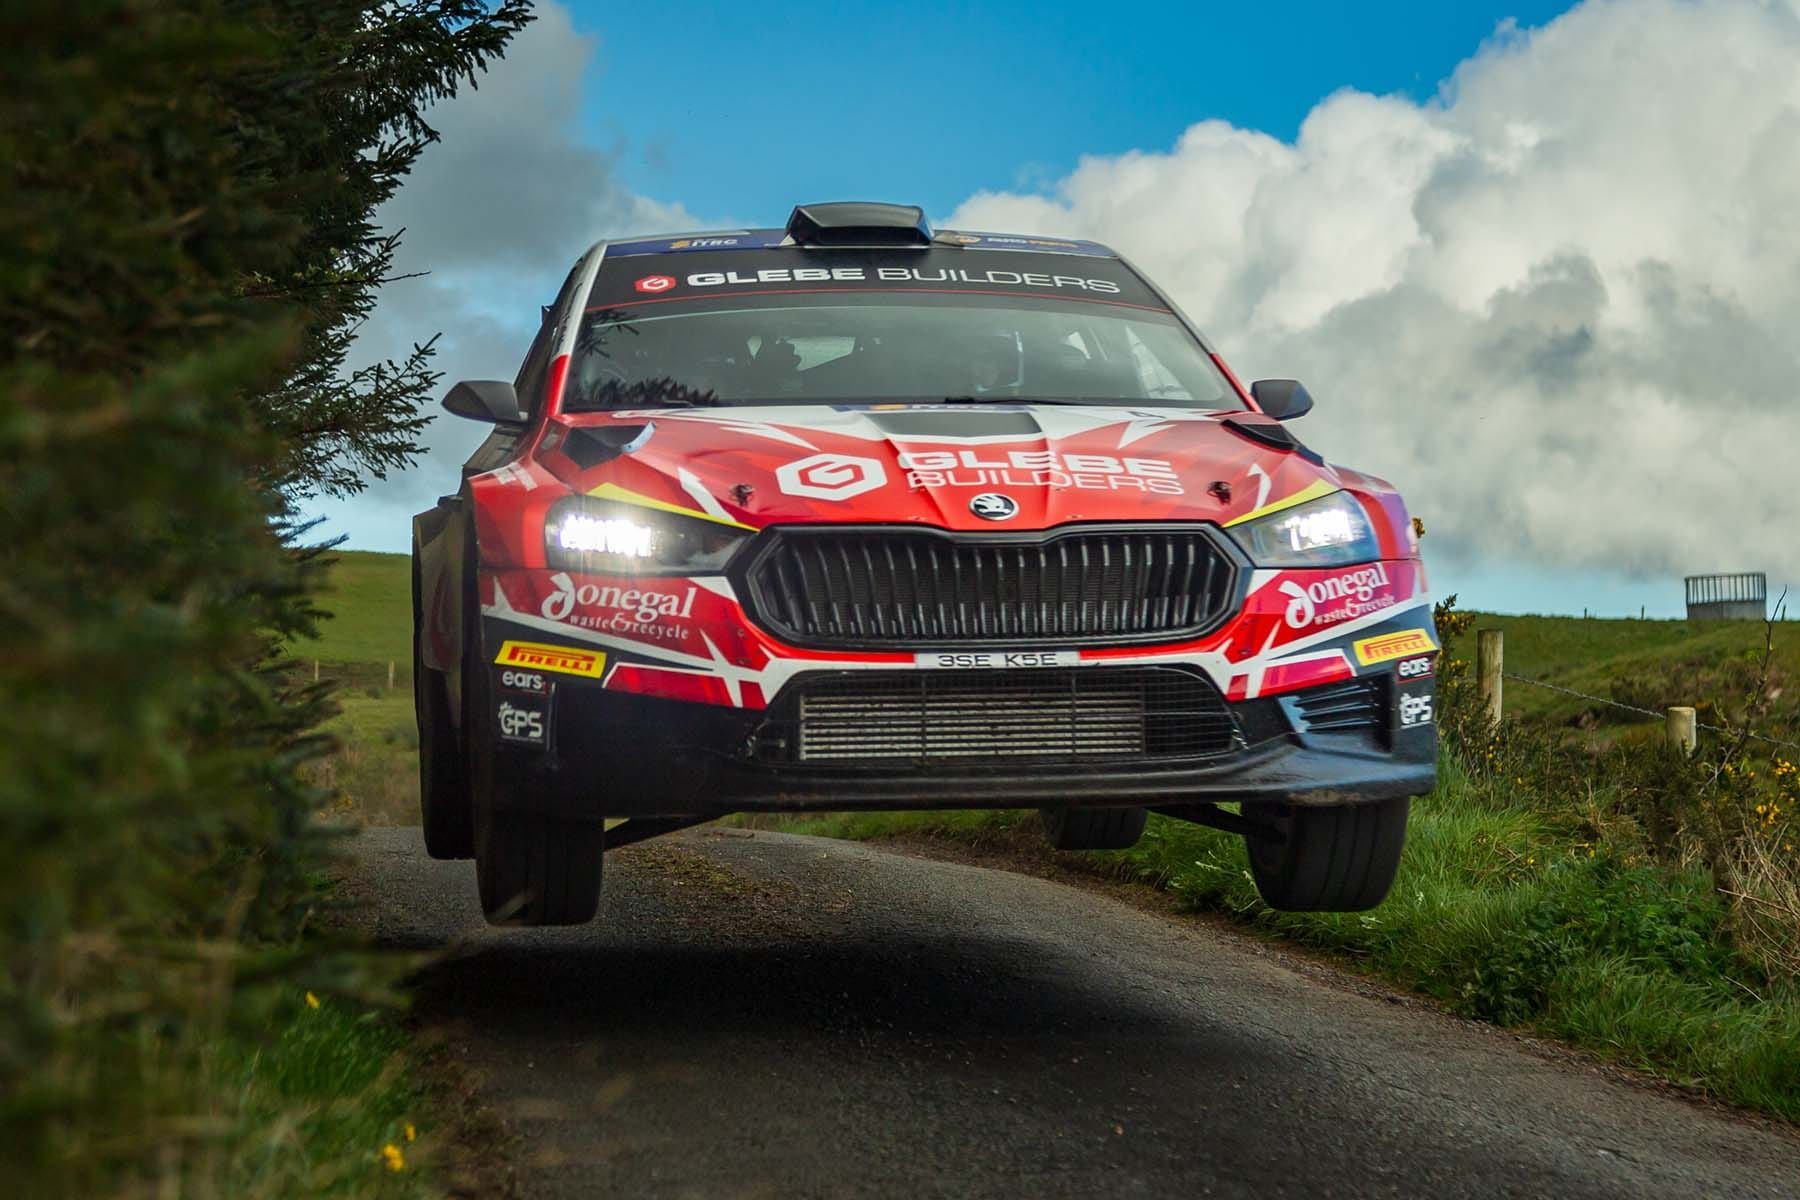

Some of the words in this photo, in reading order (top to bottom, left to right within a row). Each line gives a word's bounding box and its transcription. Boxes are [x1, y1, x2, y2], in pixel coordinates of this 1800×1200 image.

[687, 267, 866, 287] GLEBE
[877, 267, 1121, 294] BUILDERS
[898, 451, 1178, 480] GLEBE
[906, 469, 1184, 495] BUILDERS
[507, 645, 596, 672] PIRELLI
[1363, 633, 1427, 659] PIRELLI
[1004, 653, 1059, 667] K5E
[1398, 657, 1430, 677] ears
[502, 670, 543, 690] ears
